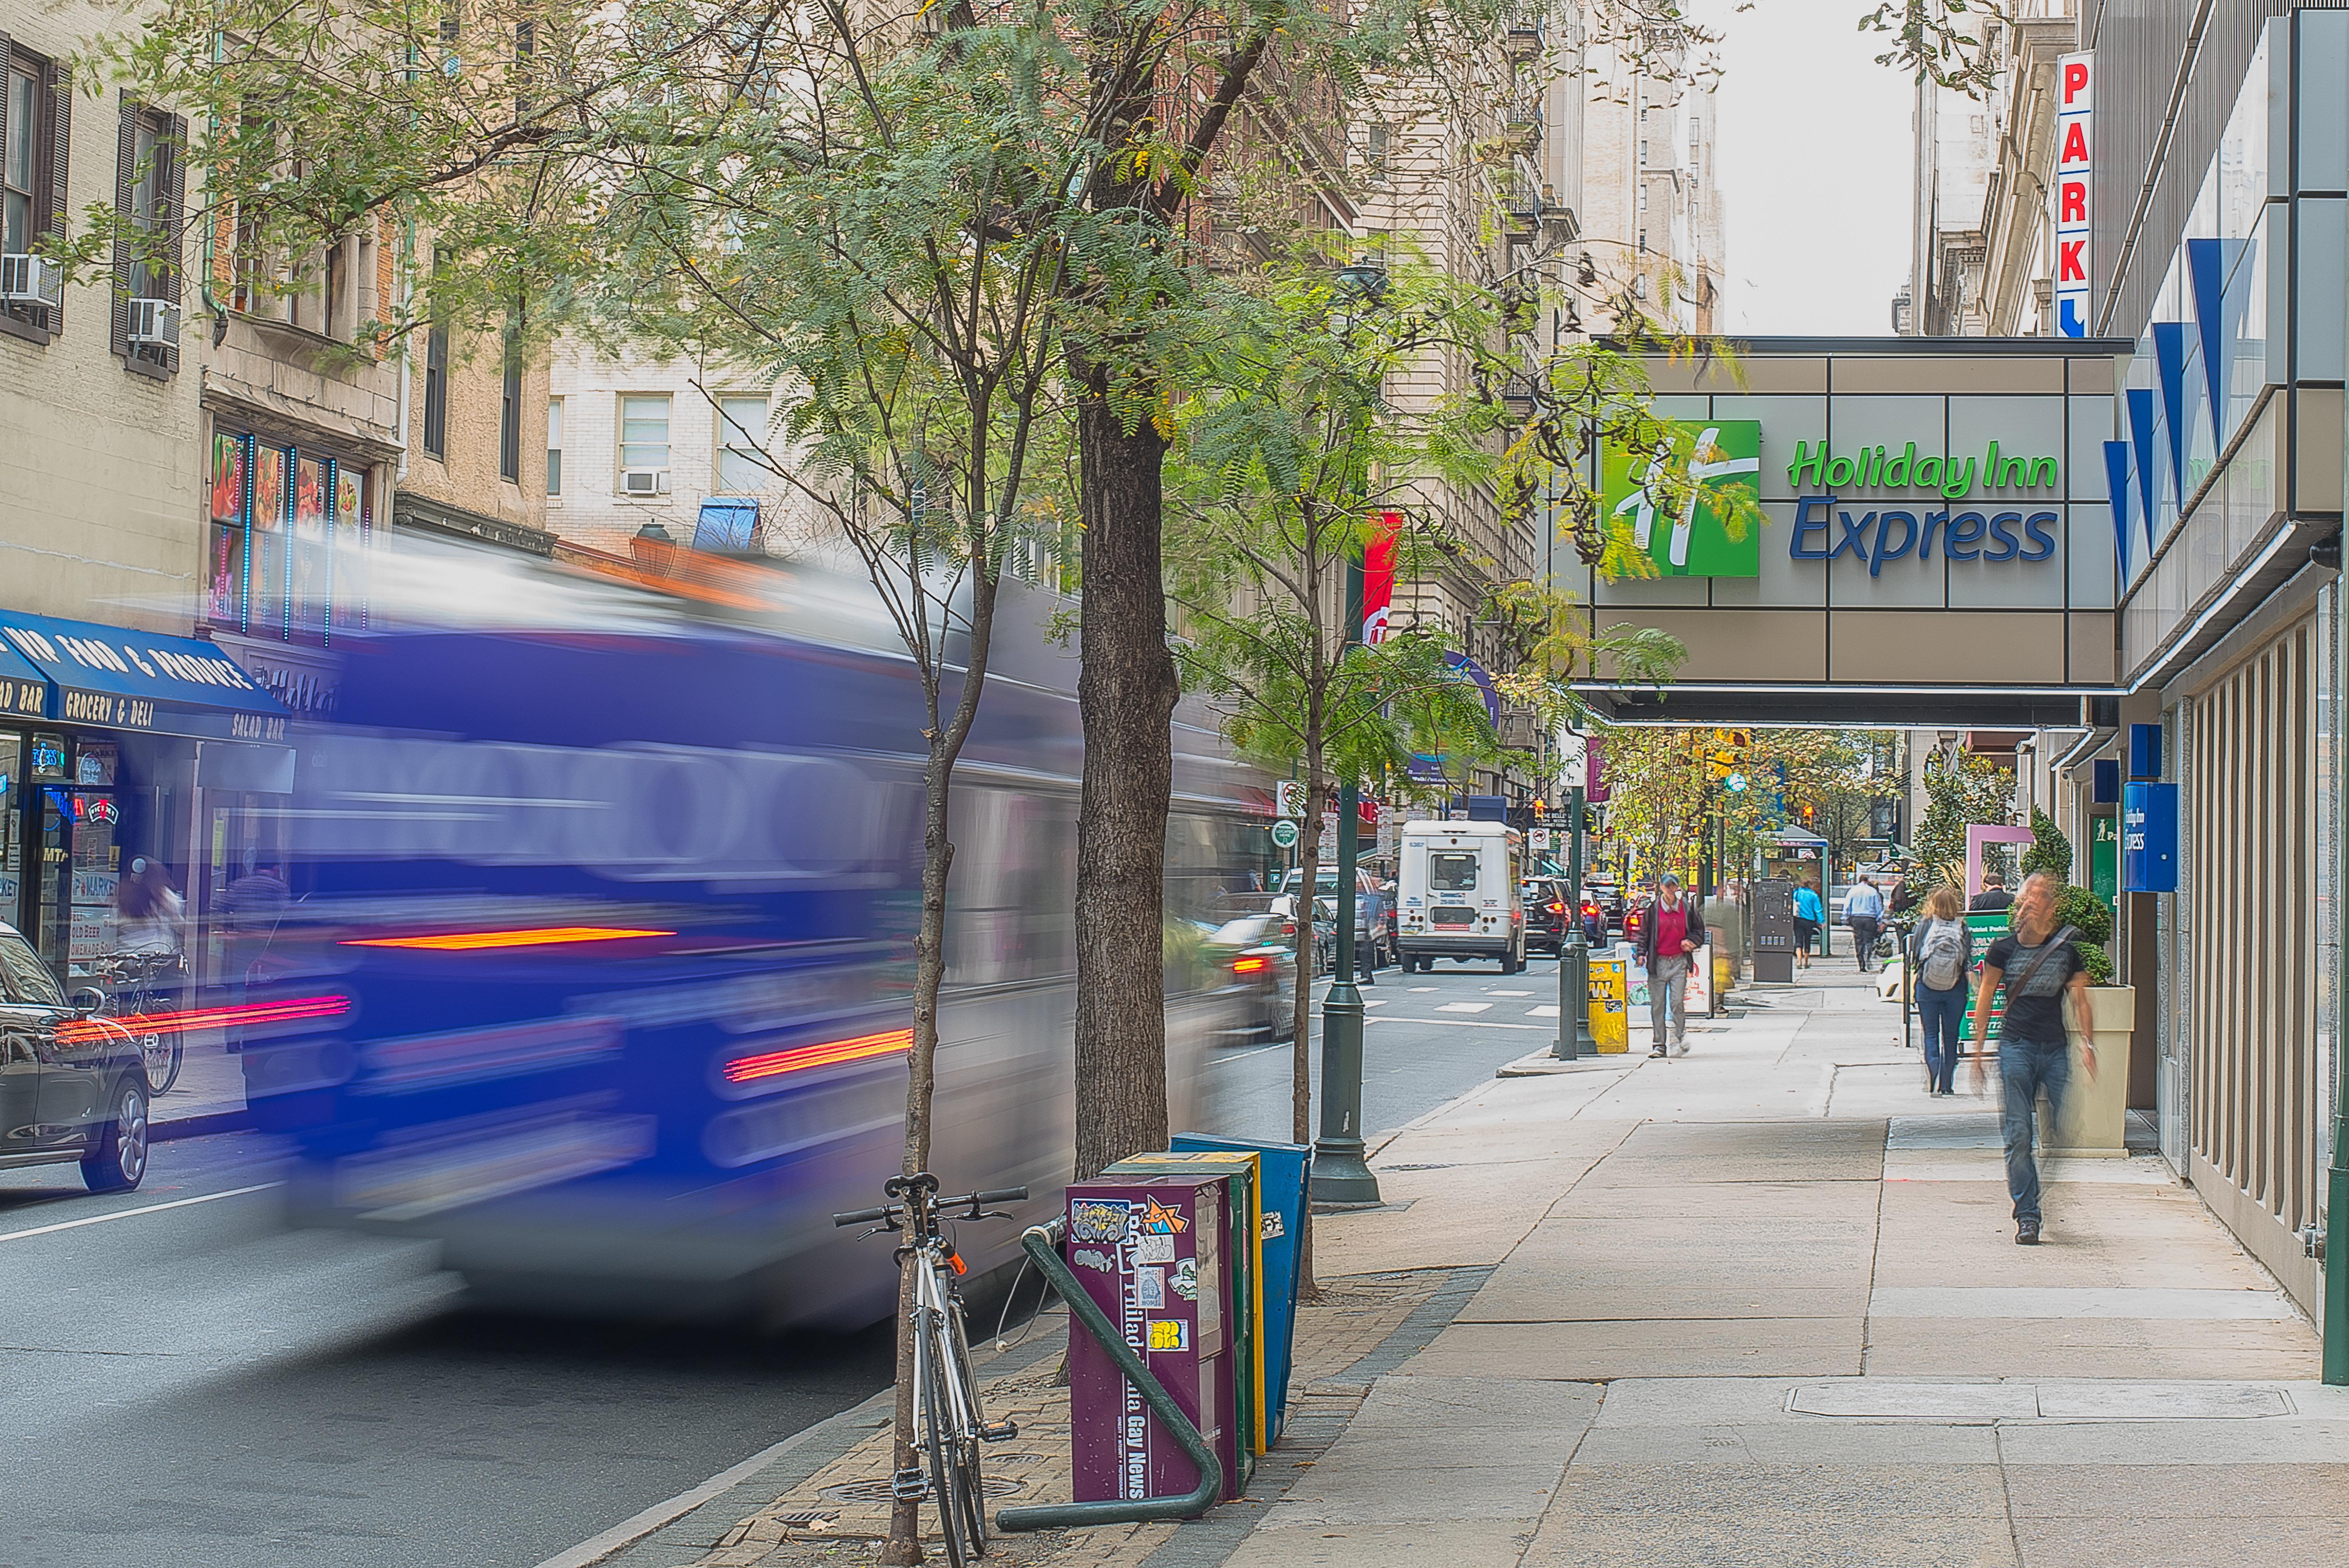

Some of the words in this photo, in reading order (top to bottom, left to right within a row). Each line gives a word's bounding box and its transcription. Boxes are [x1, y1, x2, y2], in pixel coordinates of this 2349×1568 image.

[2061, 63, 2088, 282] PARK
[1787, 440, 1975, 498] Holiday
[1983, 440, 2057, 487] Inn
[1789, 495, 2058, 578] Express
[4, 626, 61, 663] VIP
[54, 635, 129, 673] FOOD
[124, 645, 156, 678] &
[147, 649, 254, 690] PRODUCE
[19, 684, 43, 713] BAR
[66, 691, 112, 722] GROCERY
[118, 699, 125, 724] &
[130, 700, 153, 726] DELI
[232, 713, 261, 739] SALAD
[266, 717, 285, 740] BAR
[86, 876, 118, 896] MARKET
[1127, 1416, 1145, 1448] Gay
[1128, 1452, 1146, 1499] News
